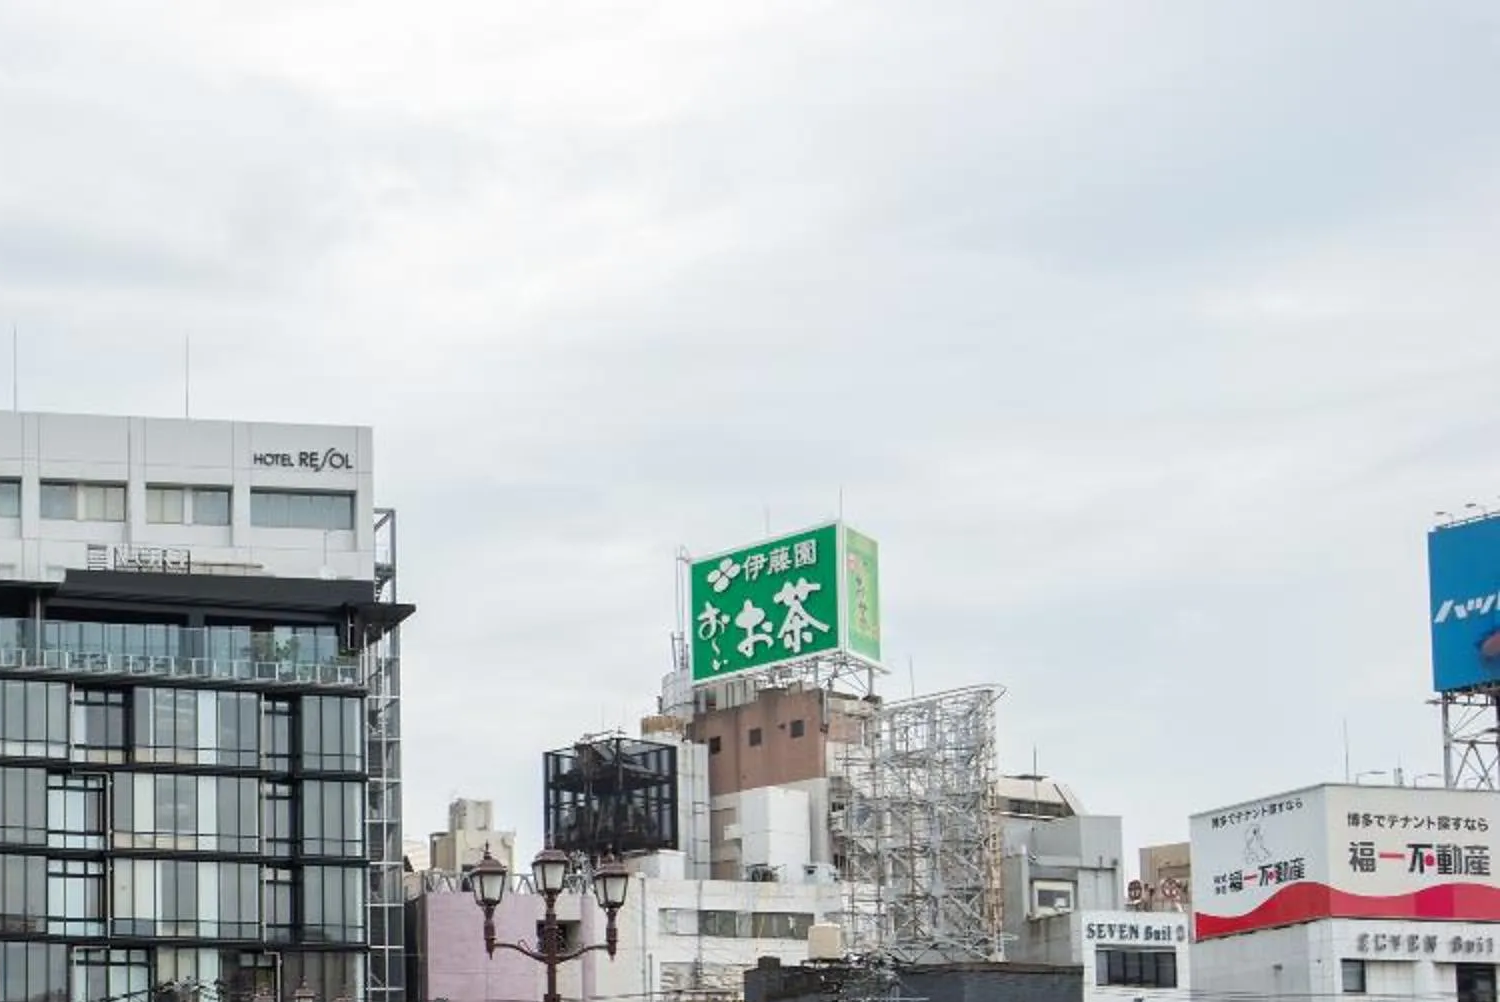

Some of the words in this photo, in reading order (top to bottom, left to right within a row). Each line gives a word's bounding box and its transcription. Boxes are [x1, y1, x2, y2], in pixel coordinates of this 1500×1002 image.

[253, 453, 294, 467] HOTEL
[743, 539, 817, 582] 伊藤園
[1347, 812, 1489, 832] 博多でテナント探すなら
[1349, 841, 1491, 876] 福一不動産
[1086, 923, 1140, 940] SEVEN
